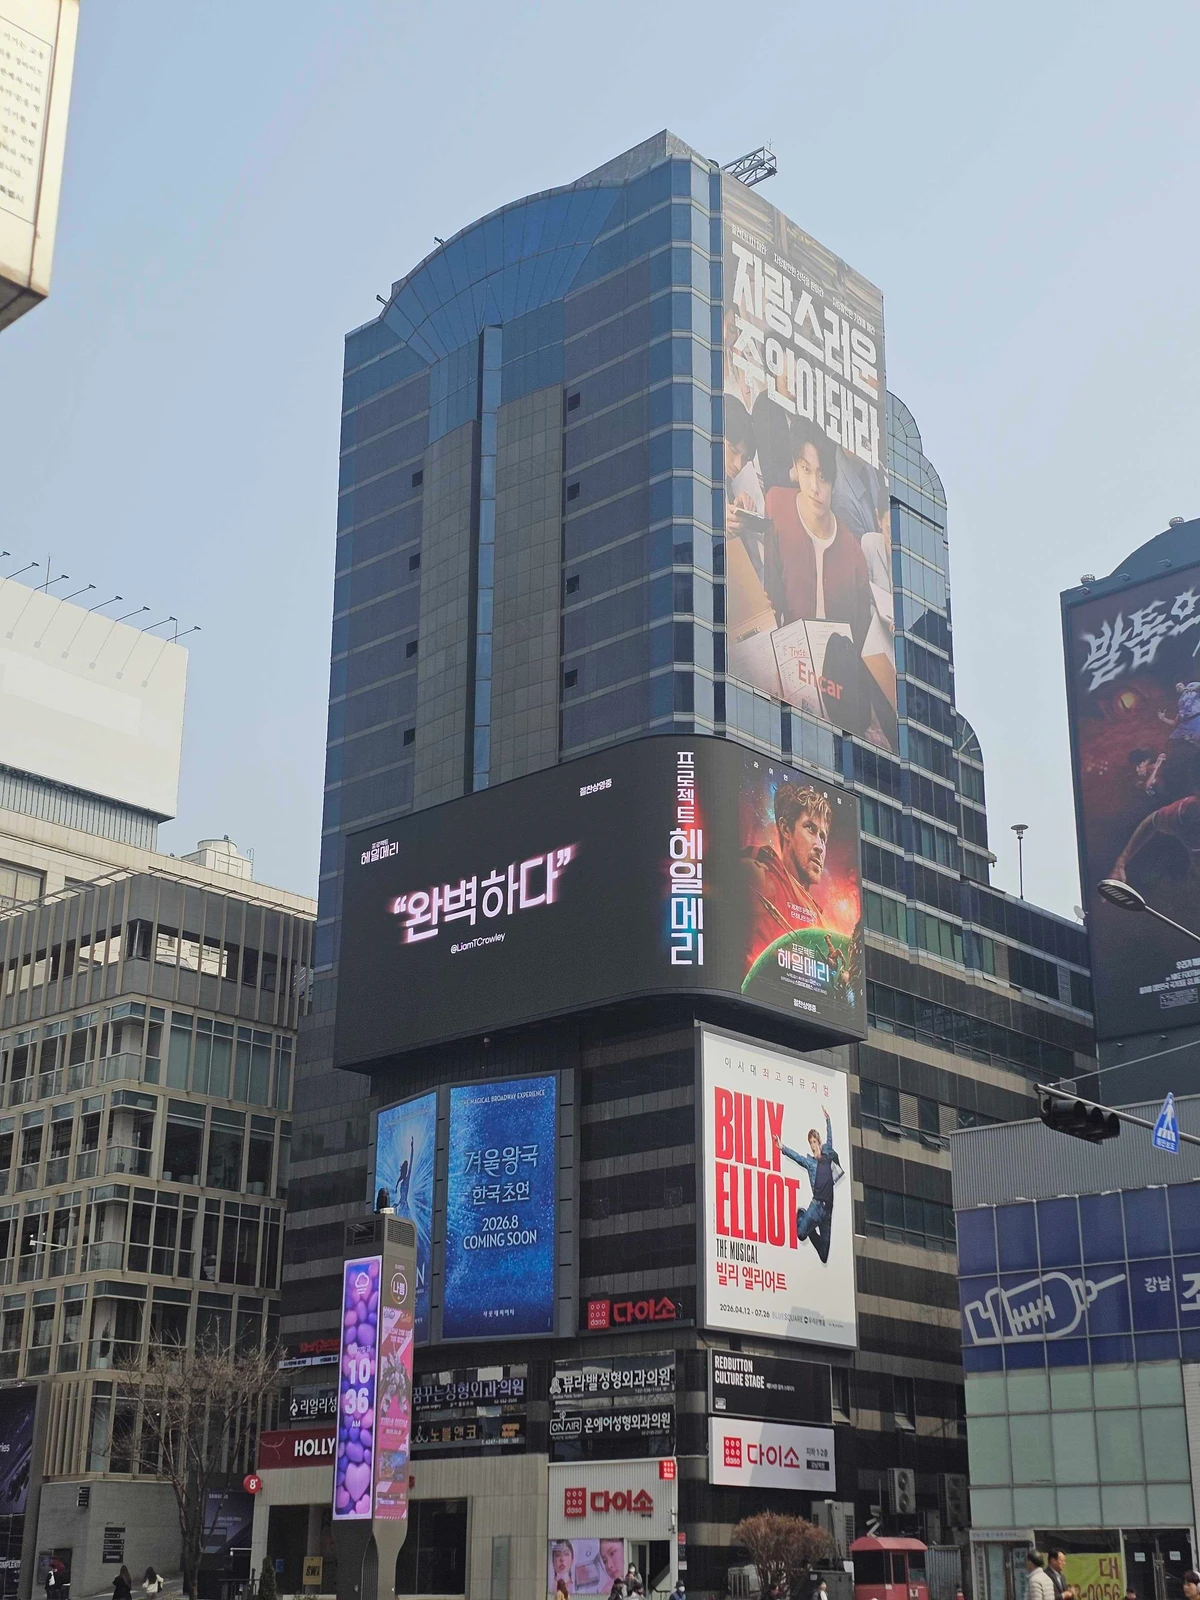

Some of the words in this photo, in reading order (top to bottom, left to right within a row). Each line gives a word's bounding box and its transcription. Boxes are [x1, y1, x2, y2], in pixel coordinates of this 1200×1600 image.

[732, 240, 879, 400] 자랑스러운
[797, 660, 843, 700] Encar
[579, 778, 613, 797] 절찬상영중
[675, 752, 695, 823] 프로젝트
[361, 842, 399, 865] 헤일메리
[669, 828, 704, 966] 헤일메리
[450, 932, 506, 954] @LiamTCrowley
[791, 943, 815, 959] 프로젝트
[777, 948, 830, 983] 헤일메리
[793, 998, 817, 1012] 절찬상영중
[471, 1097, 490, 1105] MAGICAL
[491, 1094, 516, 1103] BROADWAY
[517, 1089, 545, 1099] EXPERIENCE
[714, 1086, 784, 1172] BILLY
[465, 1144, 539, 1177] 겨울왕국
[472, 1185, 501, 1205] 한국
[502, 1181, 530, 1203] 초연
[714, 1162, 800, 1250] ELLIOT
[482, 1215, 519, 1232] 2026.8
[463, 1233, 505, 1250] COMING
[507, 1230, 537, 1246] SOON
[716, 1238, 728, 1259] THE
[729, 1240, 759, 1264] MUSICAL
[716, 1261, 739, 1287] 빌리
[742, 1265, 787, 1293] 엘리어트
[1144, 1275, 1172, 1292] 강남
[613, 1297, 676, 1322] 다이소
[720, 1303, 751, 1316] 2026.04.12
[755, 1308, 770, 1319] 07.26
[348, 1358, 371, 1384] 10
[714, 1355, 753, 1373] REDBUTTON
[715, 1370, 744, 1387] CULTURE
[744, 1375, 765, 1389] STAGE
[345, 1387, 369, 1415] 36
[431, 1424, 477, 1443] 노블앤코
[552, 1421, 565, 1431] ON
[565, 1421, 580, 1431] AIR
[584, 1412, 671, 1434] 온에어성형외과의원
[747, 1444, 800, 1468] 다이소
[590, 1489, 653, 1512] 다이소
[1098, 1557, 1119, 1579] 대
